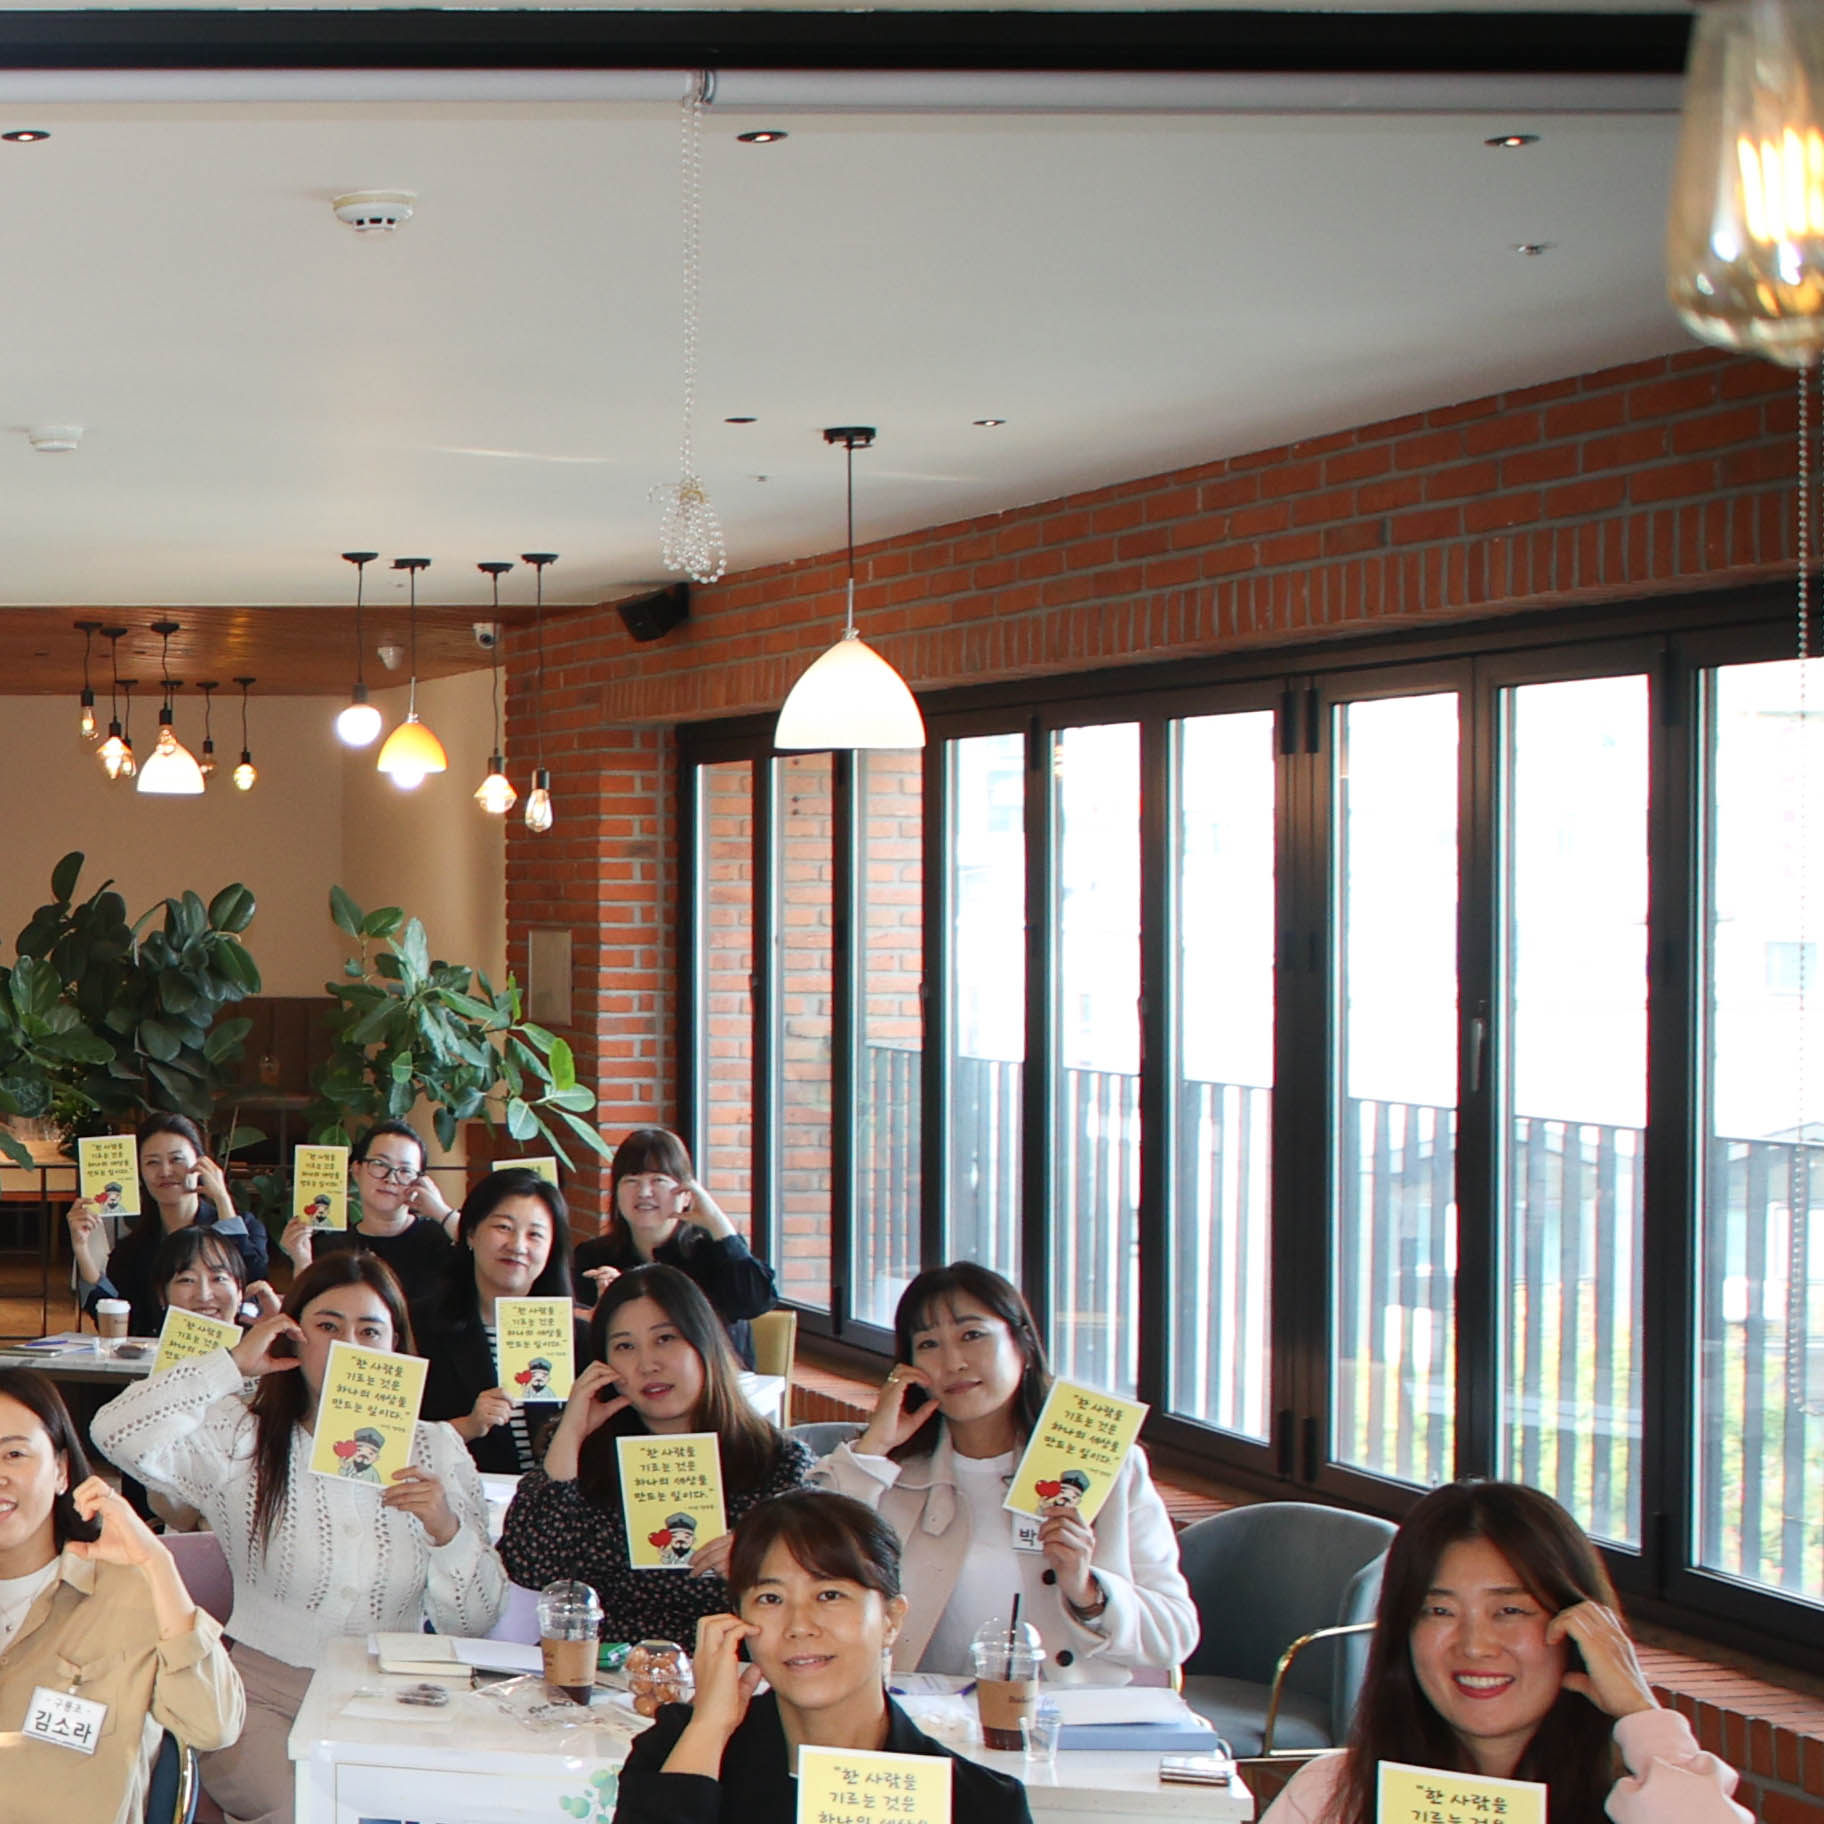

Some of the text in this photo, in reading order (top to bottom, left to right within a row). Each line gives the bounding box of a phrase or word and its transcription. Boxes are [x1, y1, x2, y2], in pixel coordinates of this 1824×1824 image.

[35, 1710, 92, 1743] 김소라
[864, 1771, 917, 1790] 사람을
[830, 1792, 915, 1812] 기르는 것은
[1450, 1793, 1508, 1814] 사람을
